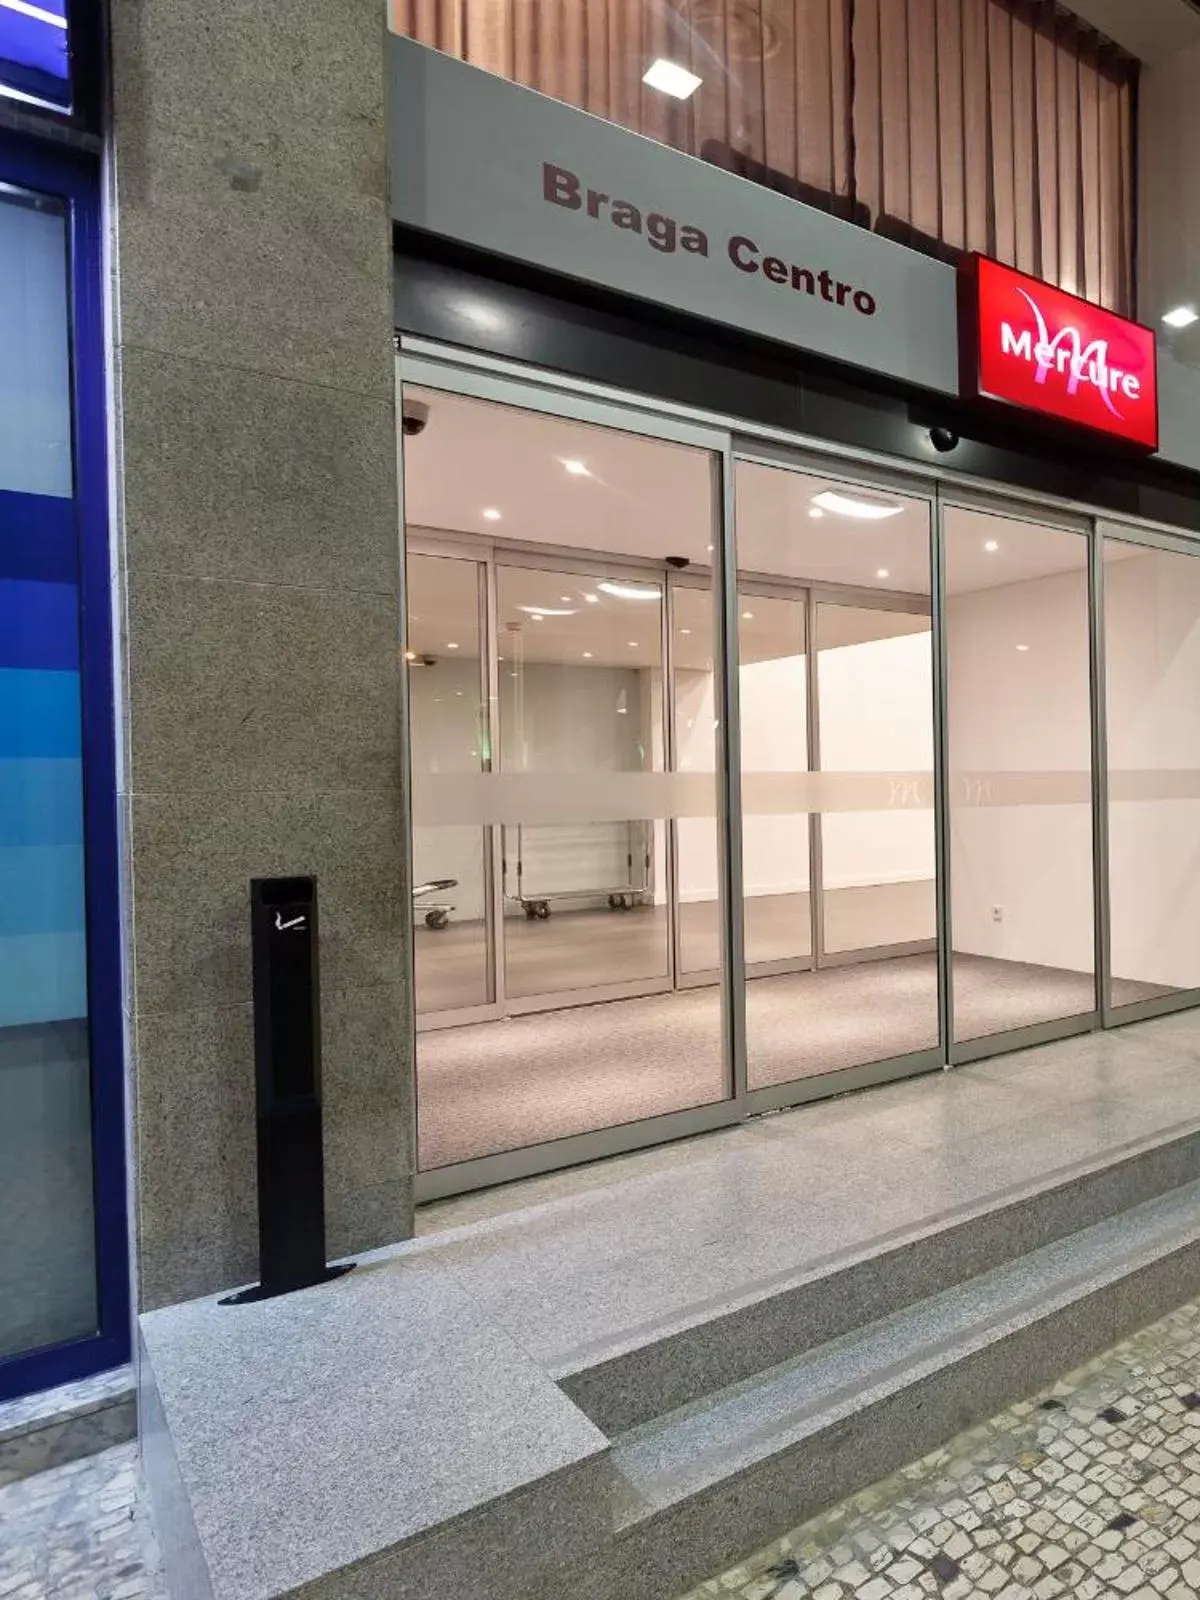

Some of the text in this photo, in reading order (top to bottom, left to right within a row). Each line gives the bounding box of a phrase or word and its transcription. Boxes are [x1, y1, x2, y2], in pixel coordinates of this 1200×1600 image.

[543, 162, 876, 316] Braga Centro
[1000, 321, 1141, 400] Mercure
